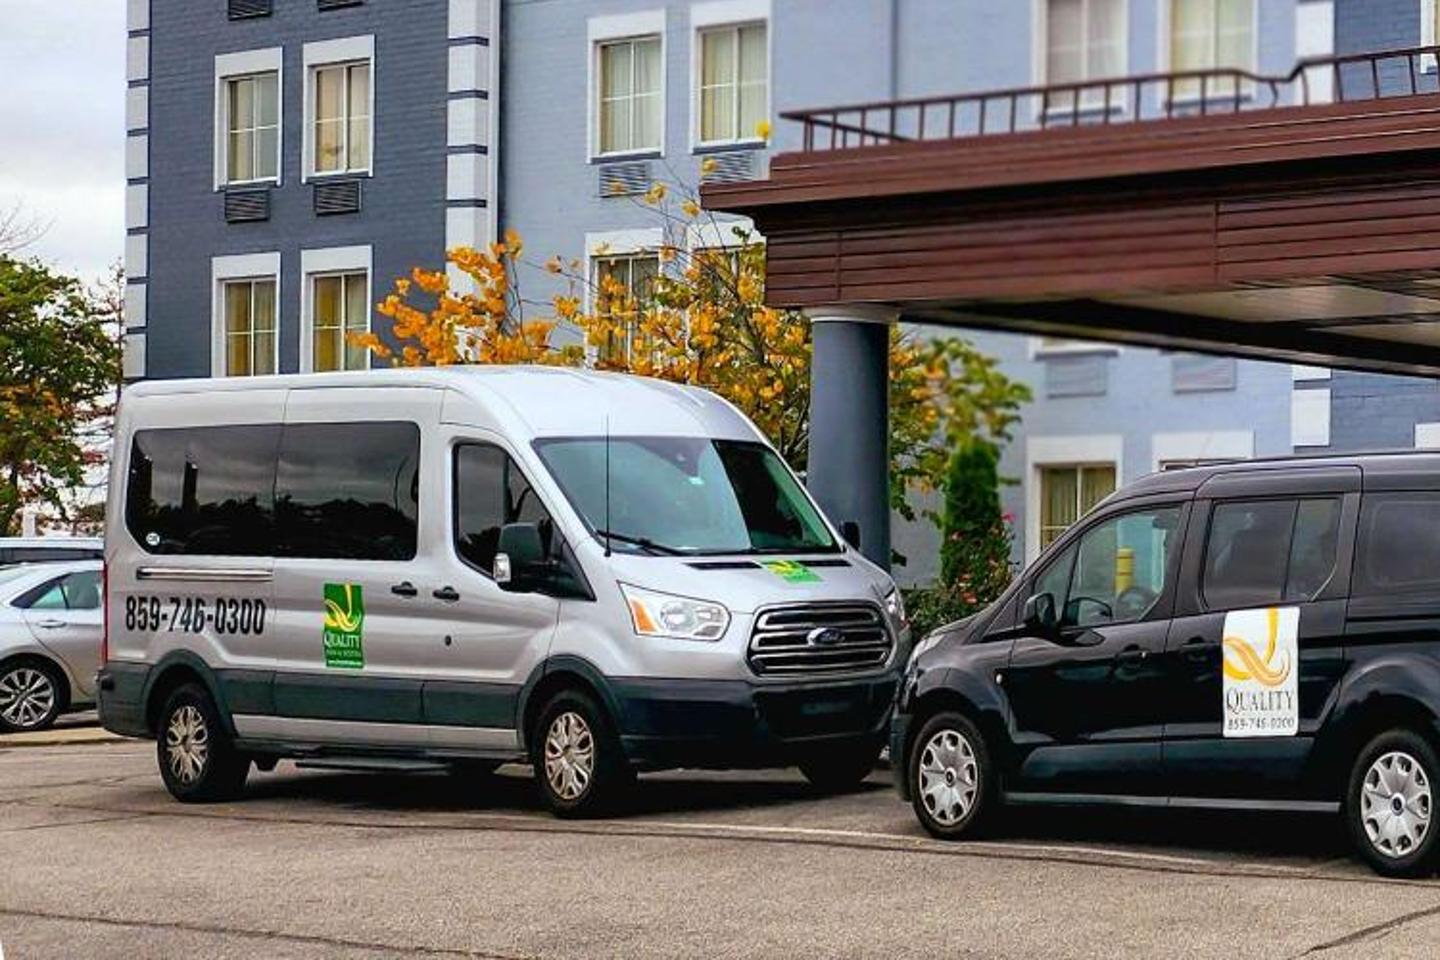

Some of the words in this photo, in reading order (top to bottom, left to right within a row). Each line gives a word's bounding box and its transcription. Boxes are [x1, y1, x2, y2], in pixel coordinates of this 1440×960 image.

[126, 596, 265, 634] 859-746-0300
[324, 631, 360, 648] QUALITY
[1226, 687, 1294, 715] QUALITY
